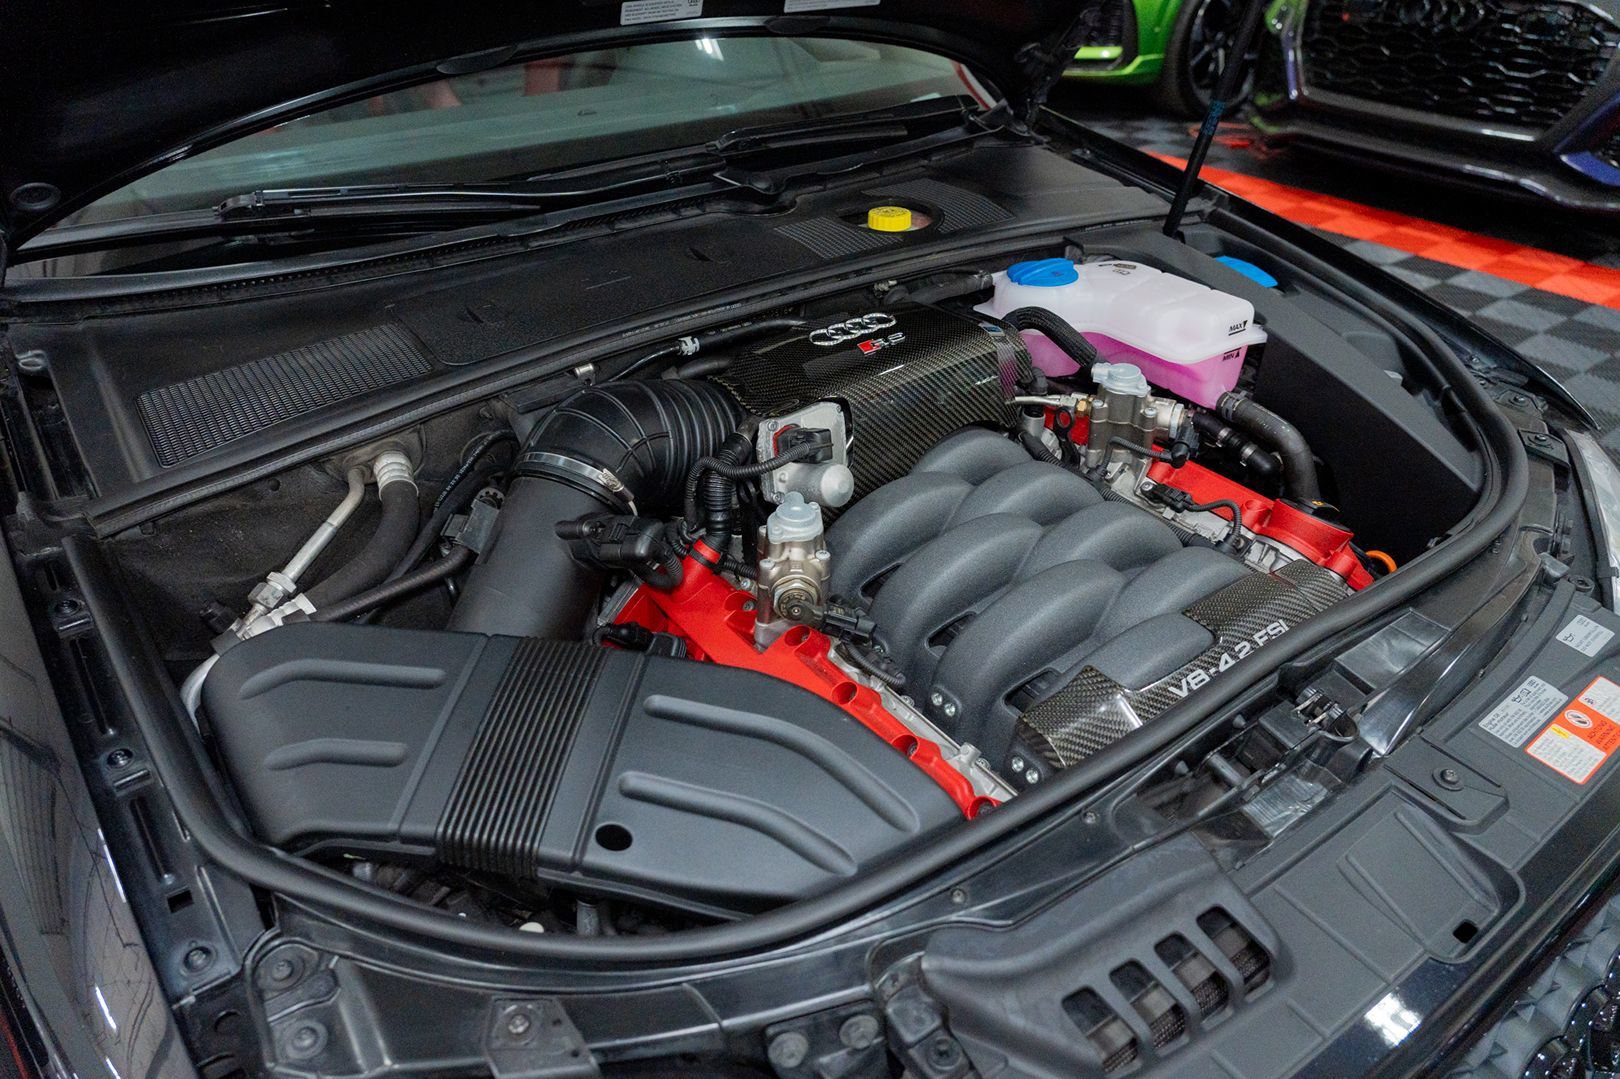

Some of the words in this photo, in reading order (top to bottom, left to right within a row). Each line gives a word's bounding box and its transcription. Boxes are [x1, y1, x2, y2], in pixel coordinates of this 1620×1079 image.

[1229, 322, 1243, 332] MAX
[1222, 353, 1235, 361] MIN
[1253, 619, 1290, 647] FSI
